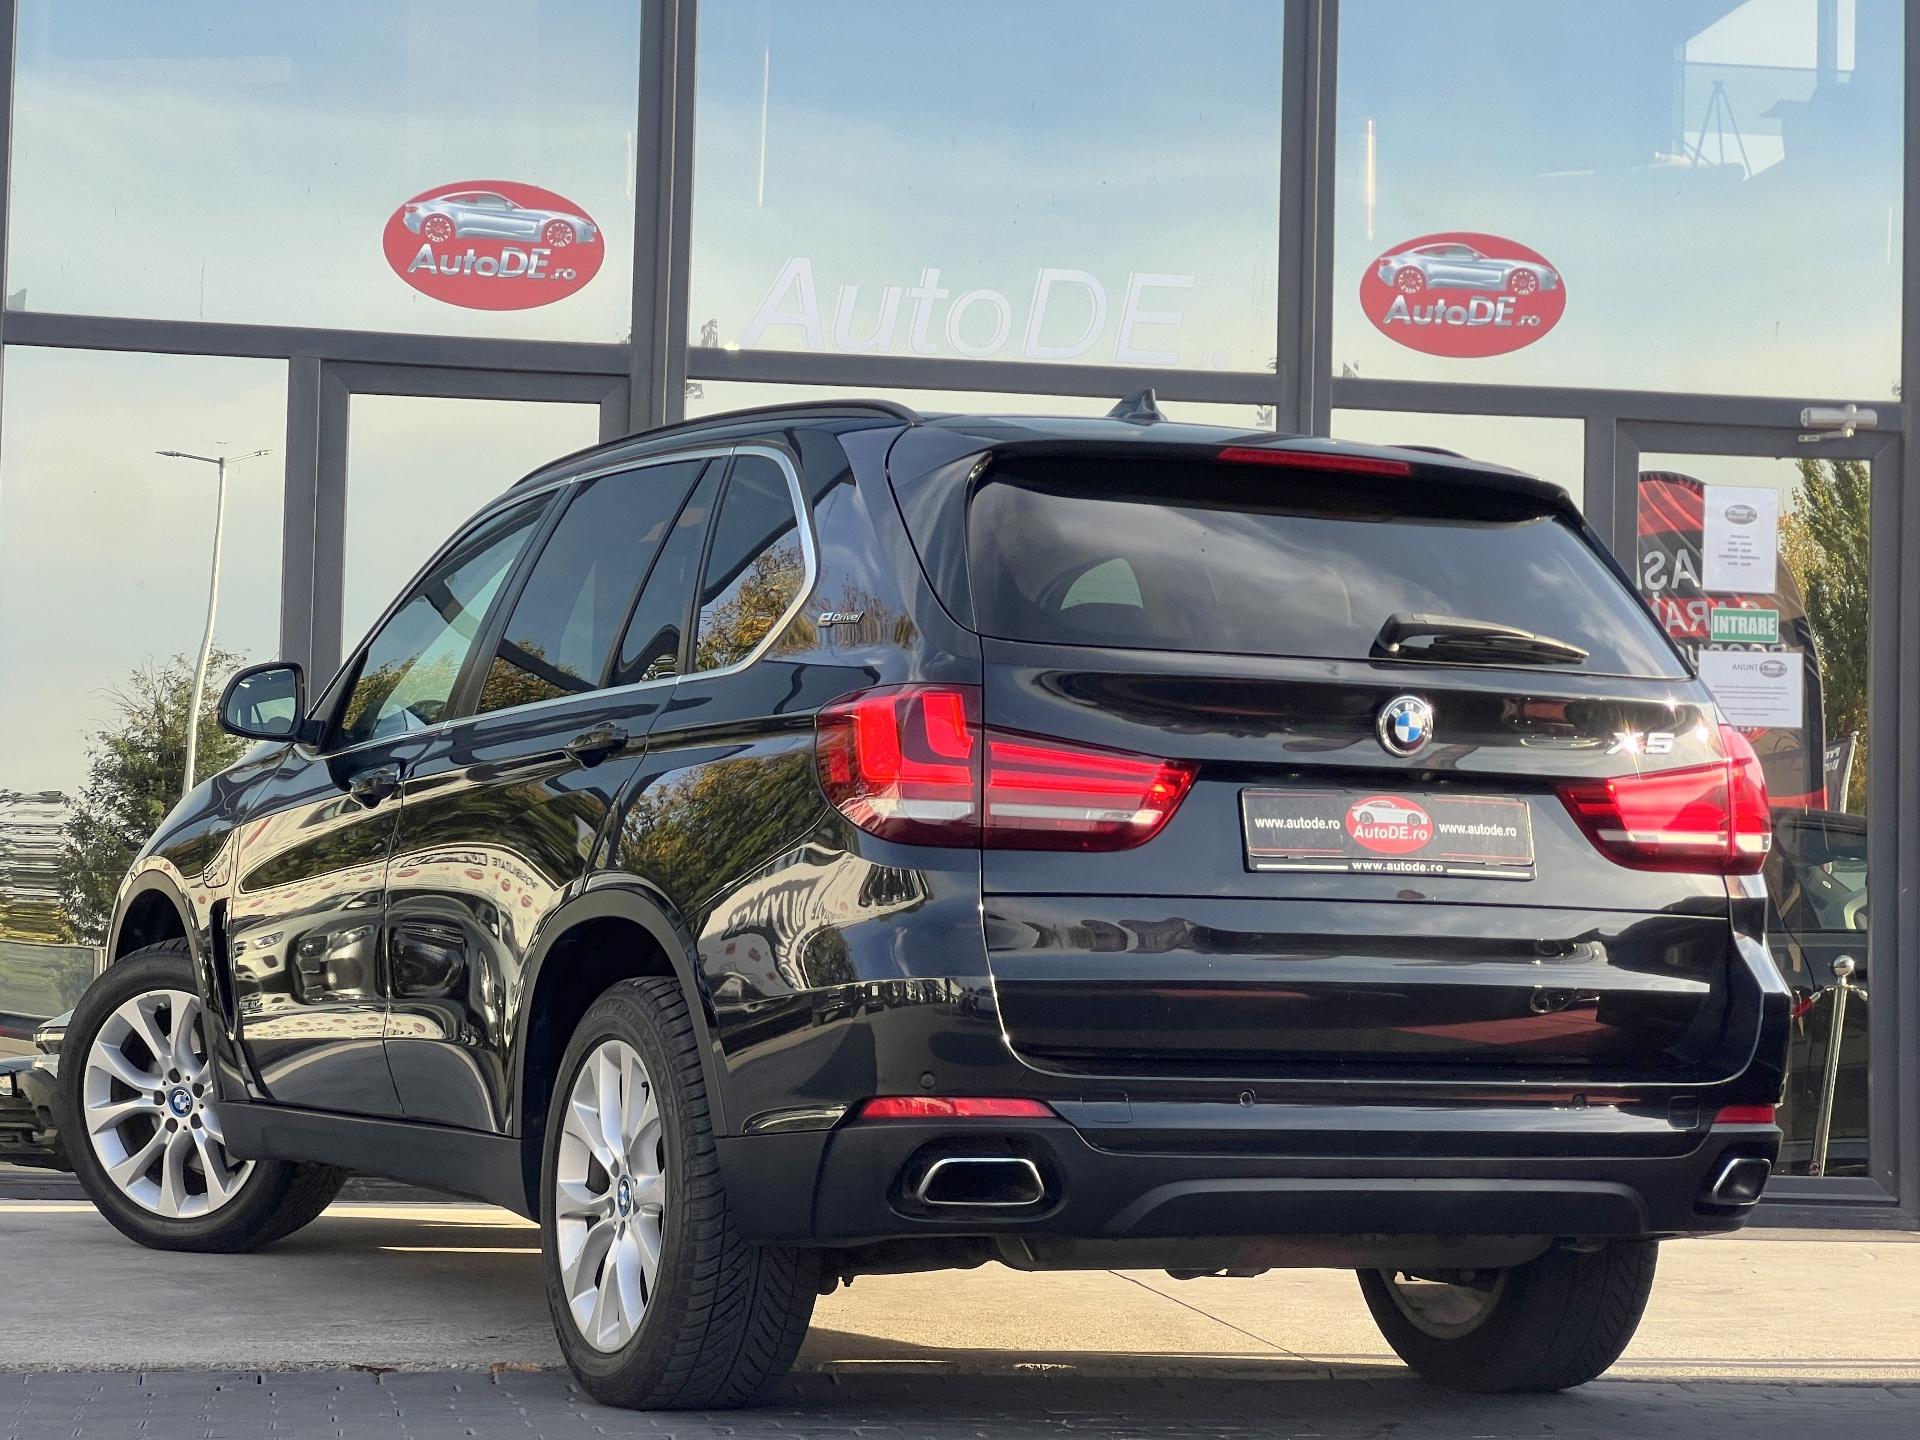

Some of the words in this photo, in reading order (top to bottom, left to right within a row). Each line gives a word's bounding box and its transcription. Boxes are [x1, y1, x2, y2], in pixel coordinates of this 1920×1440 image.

[407, 243, 577, 281] AutoDE.ro
[1383, 294, 1541, 327] AutoDE.ro
[1713, 615, 1776, 635] INTRARE
[1605, 731, 1675, 755] X5
[1255, 816, 1340, 830] www.autode.ro
[1438, 823, 1517, 837] www.autode.ro
[1353, 825, 1428, 841] AutoDE.ro
[1352, 860, 1444, 873] www.autode.ro
